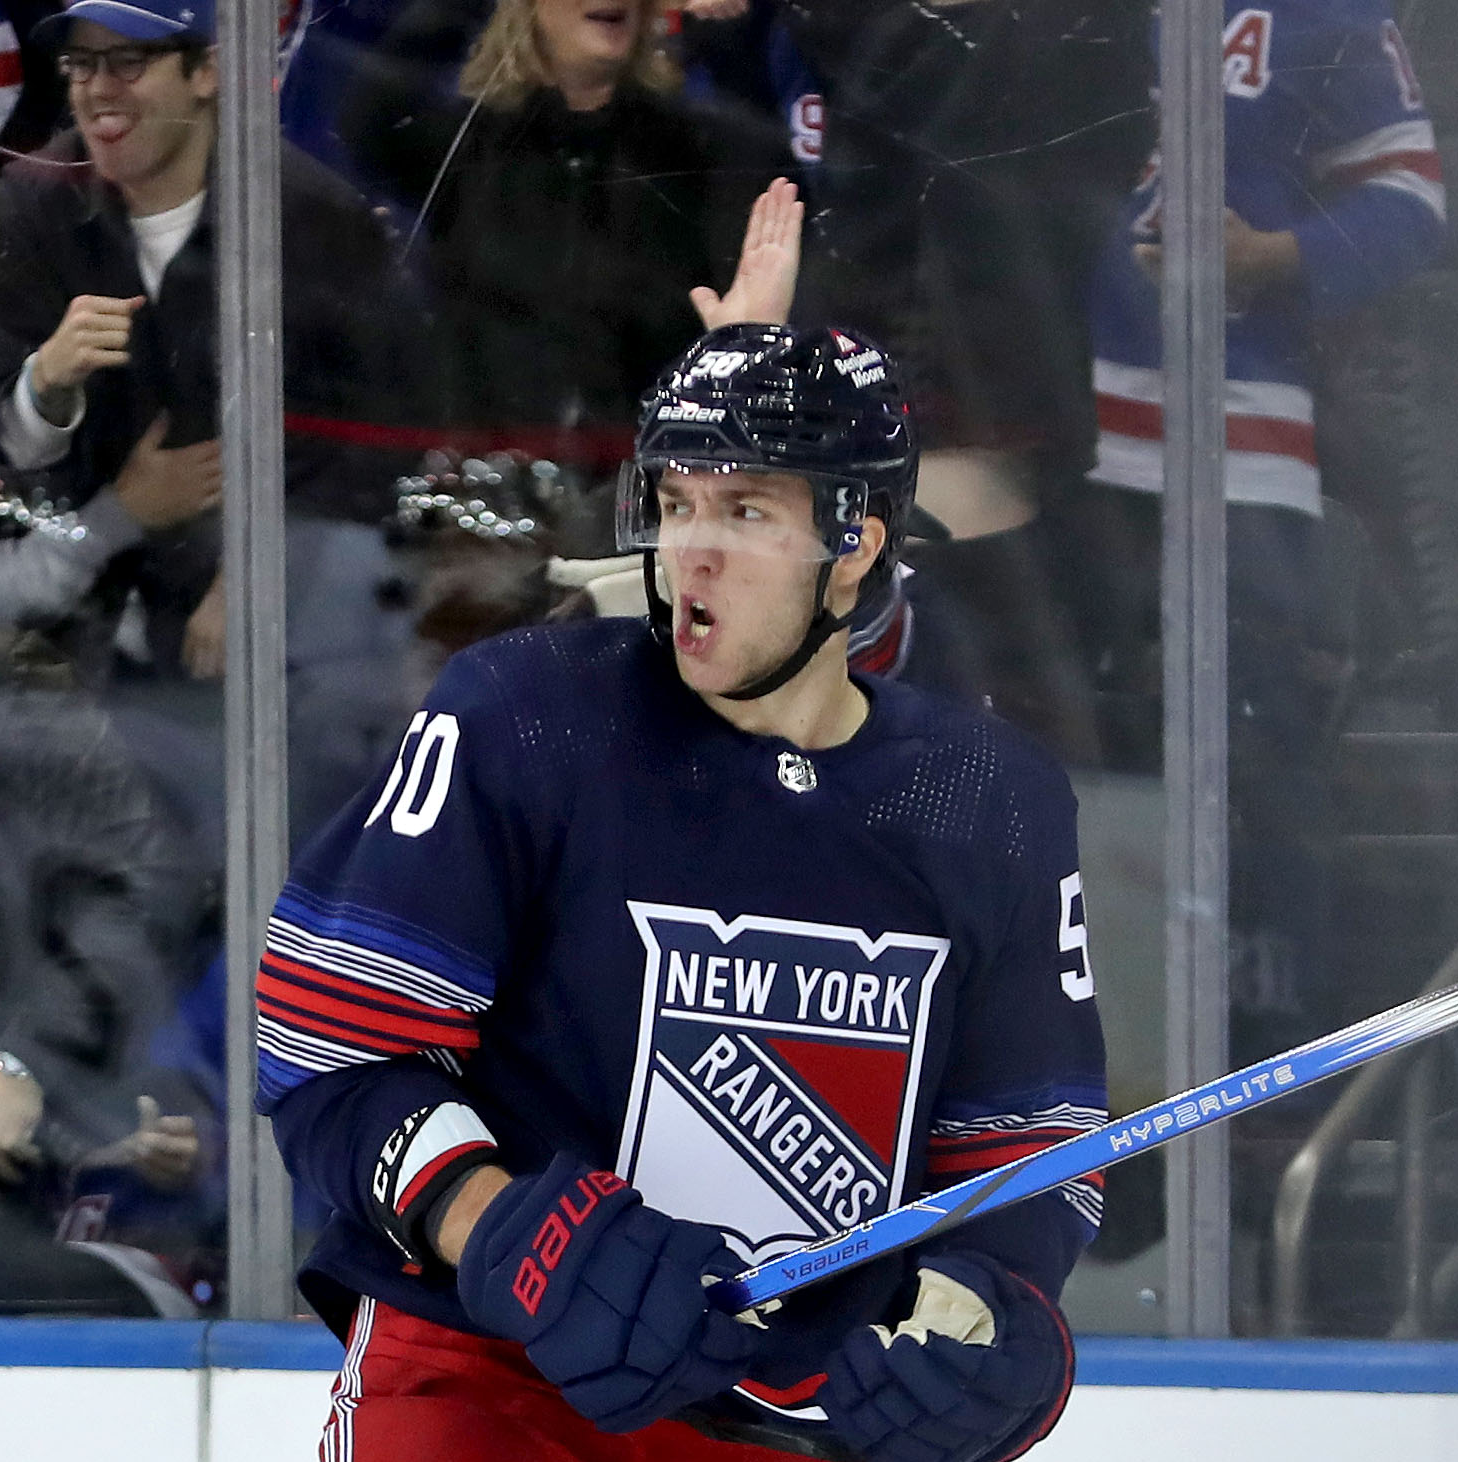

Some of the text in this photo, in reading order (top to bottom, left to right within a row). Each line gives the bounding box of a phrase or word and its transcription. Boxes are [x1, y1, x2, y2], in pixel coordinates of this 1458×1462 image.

[690, 350, 747, 380] 50
[833, 347, 884, 375] Benjamin
[851, 366, 887, 390] Moore
[665, 949, 913, 1031] NEW YORK
[688, 1032, 883, 1228] RANGERS
